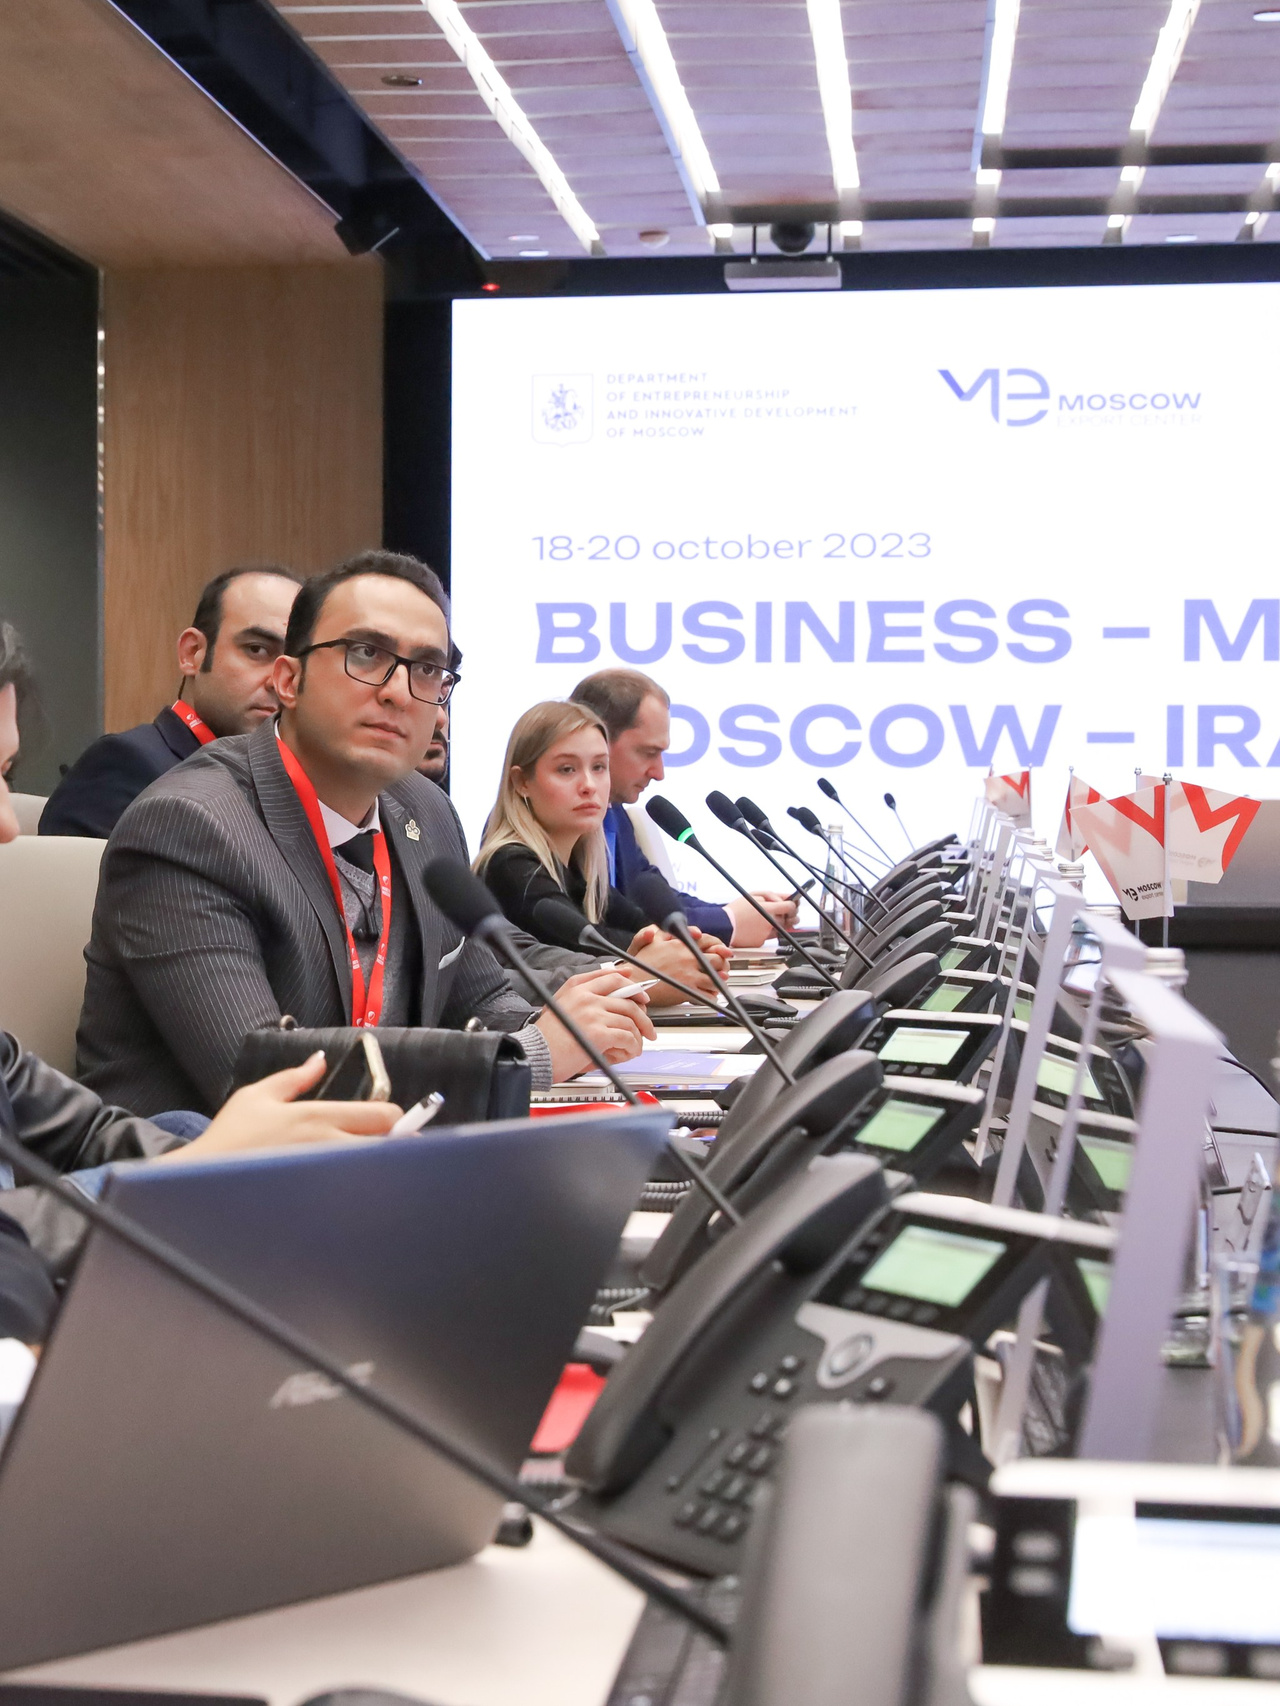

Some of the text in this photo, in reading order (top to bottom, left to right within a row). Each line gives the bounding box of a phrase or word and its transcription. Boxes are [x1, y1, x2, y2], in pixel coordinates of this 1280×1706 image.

[606, 372, 708, 385] DEPARTMENT
[606, 389, 791, 402] OF ENTREPRENEURSHIP
[1058, 392, 1202, 411] MOSCOW
[606, 405, 858, 420] AND INNOVATIVE DEVELOPMENT
[606, 426, 705, 438] OF MOSCOW
[531, 532, 932, 561] 18-20 october 2023
[534, 598, 1073, 664] BUSINESS
[665, 703, 1062, 768] OSCOW
[1166, 704, 1280, 768] IR
